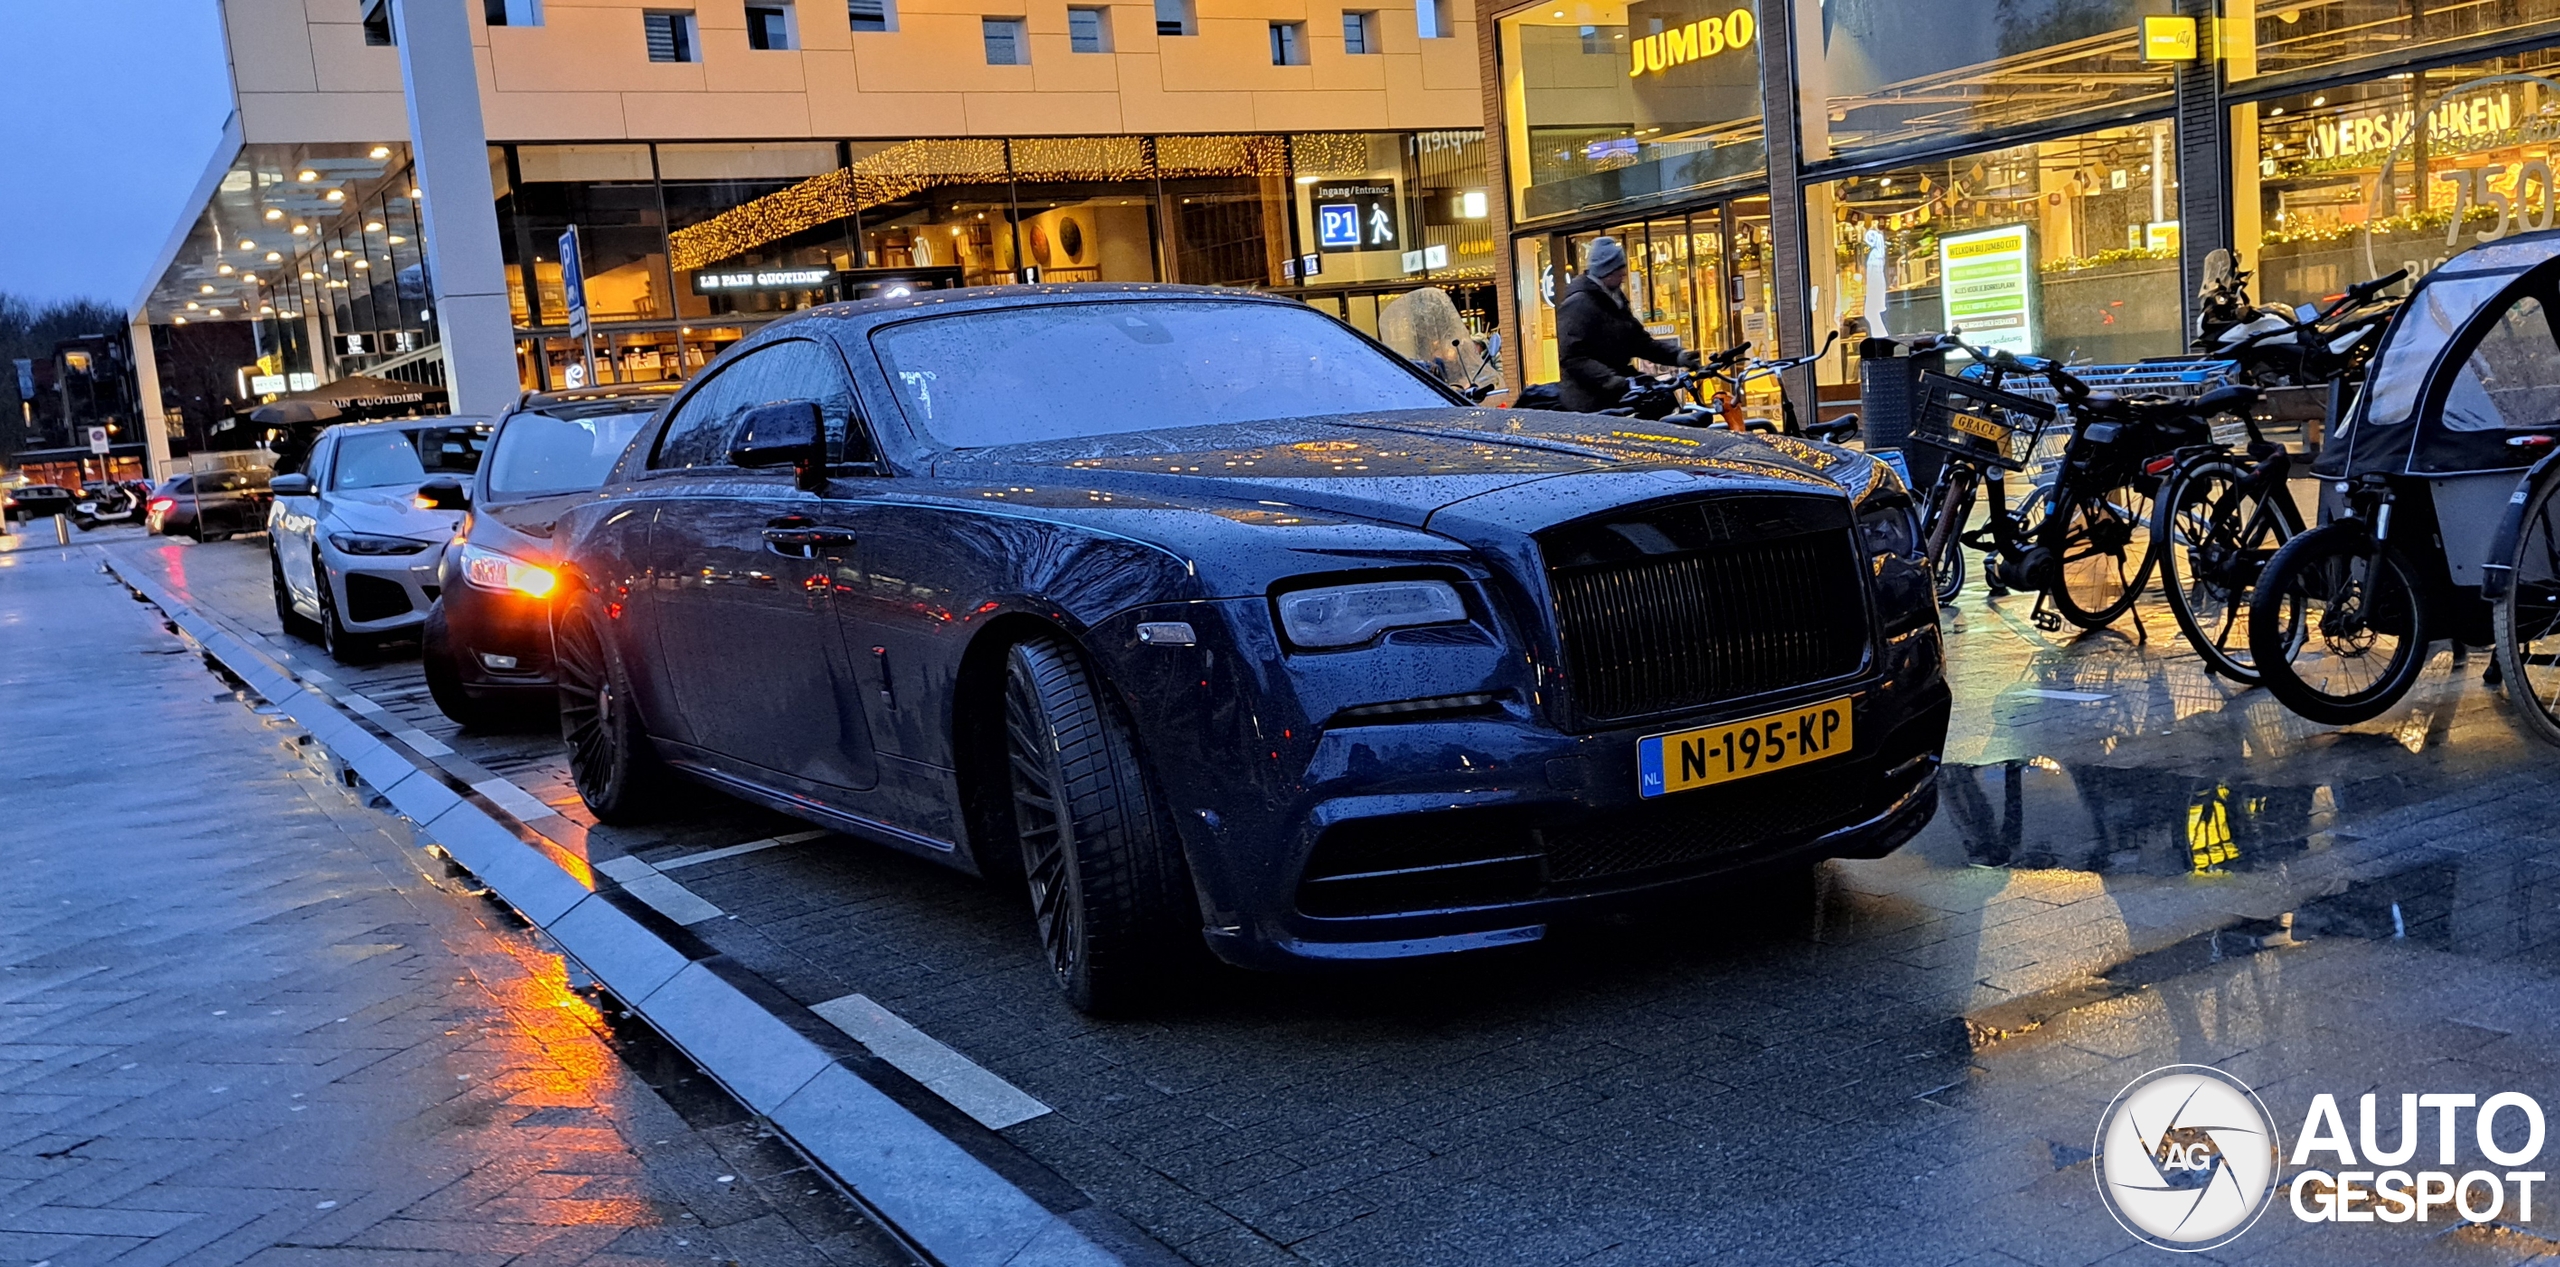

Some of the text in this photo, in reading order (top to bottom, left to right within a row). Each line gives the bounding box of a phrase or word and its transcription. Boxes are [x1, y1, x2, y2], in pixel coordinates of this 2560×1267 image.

[1629, 8, 1755, 77] JUMBO
[2317, 93, 2511, 158] VERSKUKEN
[2441, 159, 2554, 247] 750
[1324, 211, 1356, 238] P1
[562, 243, 571, 278] P
[1985, 241, 2004, 252] JUMBO
[700, 275, 719, 288] LE
[721, 273, 754, 287] PAIN
[357, 392, 423, 407] QUOTIDIEN
[1958, 416, 1998, 437] GRACE
[1644, 708, 1840, 787] NL N-195-KP
